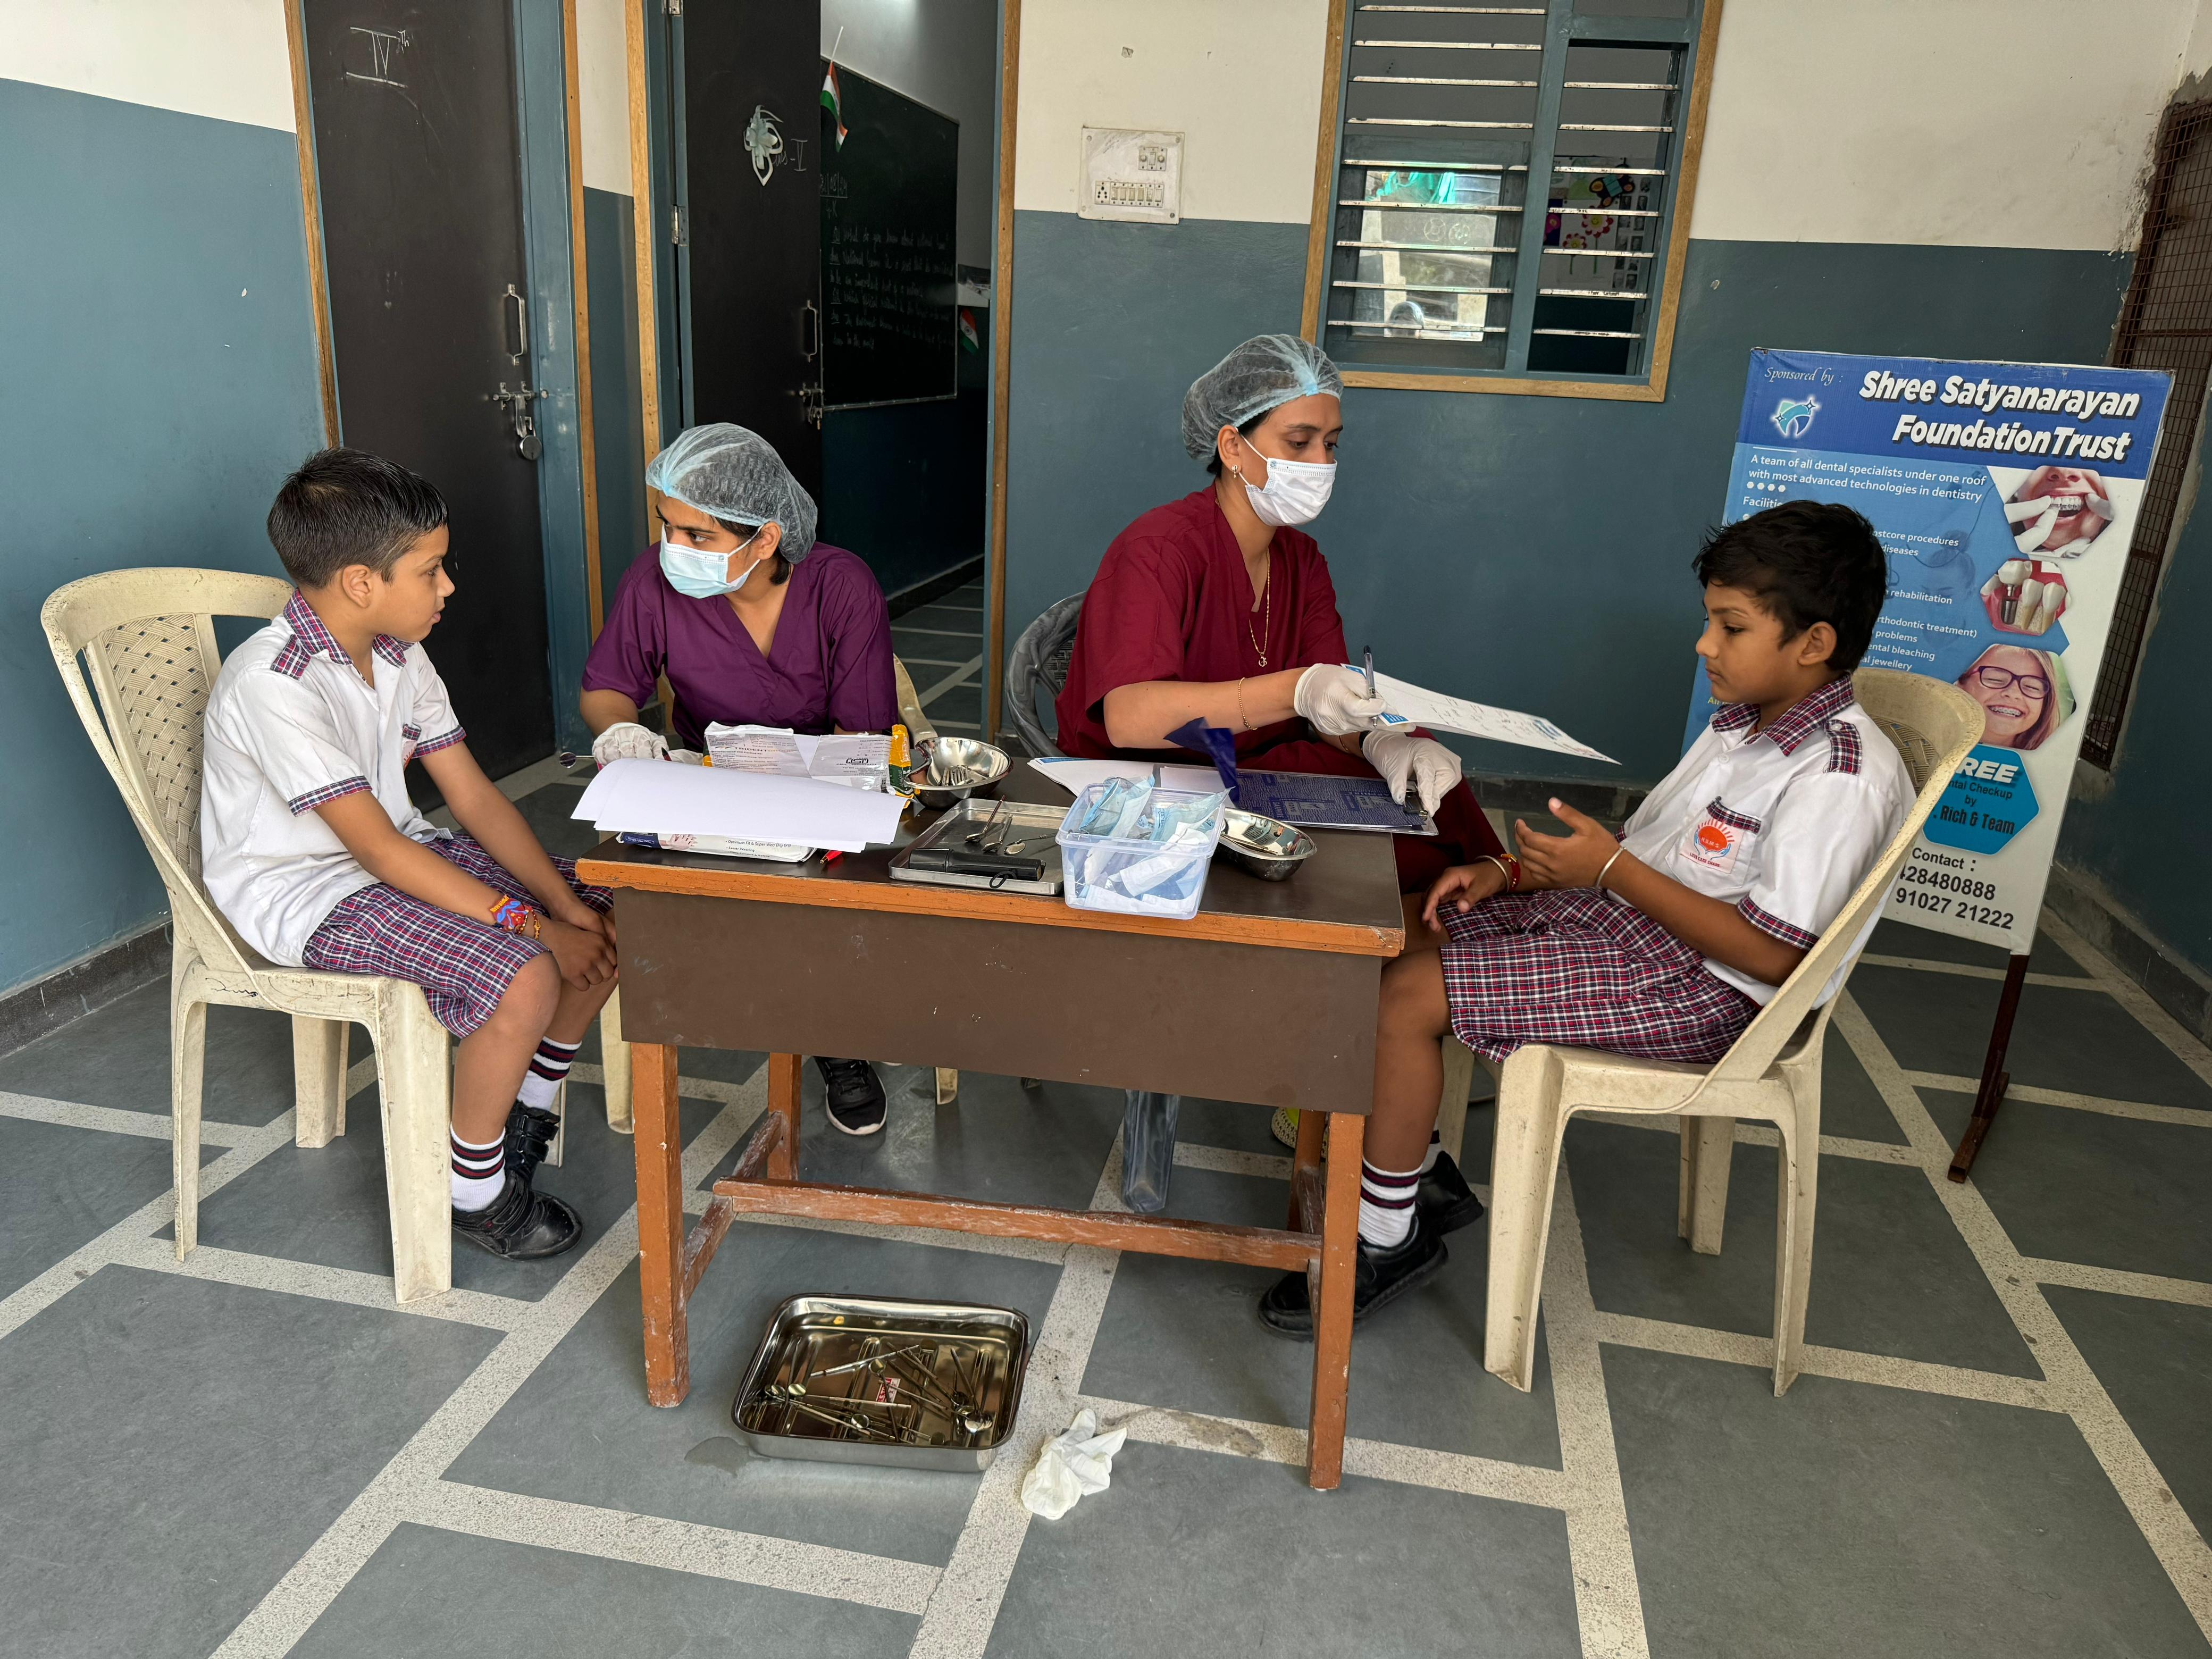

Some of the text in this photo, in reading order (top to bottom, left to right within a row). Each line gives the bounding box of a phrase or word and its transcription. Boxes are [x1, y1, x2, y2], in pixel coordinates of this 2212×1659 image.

[1764, 367, 1822, 382] Sponsored
[1821, 367, 1834, 386] by
[1859, 371, 2140, 420] Shree Satyanarayan
[1751, 455, 1988, 485] A team of all dental specialists under one roof
[1749, 469, 1982, 504] with most advanced technologies in dentistry
[1743, 496, 1784, 509] Facilitie
[1872, 531, 1959, 547] ostcore procedures
[1891, 590, 1953, 605] rehabilitation
[1875, 630, 1917, 642] problems
[1877, 616, 1977, 638] rthodontic treatment)
[1867, 643, 1936, 661] ental bleaching
[1871, 657, 1913, 672] jewellery
[1956, 757, 2019, 783] REE
[1948, 780, 2013, 800] ntal Checkup
[1964, 794, 1977, 807] by
[1940, 805, 2015, 835] Rich & Team
[1912, 847, 1965, 870] Contact
[1900, 864, 1996, 900] 428480888
[1896, 887, 2014, 930] 91027 21222
